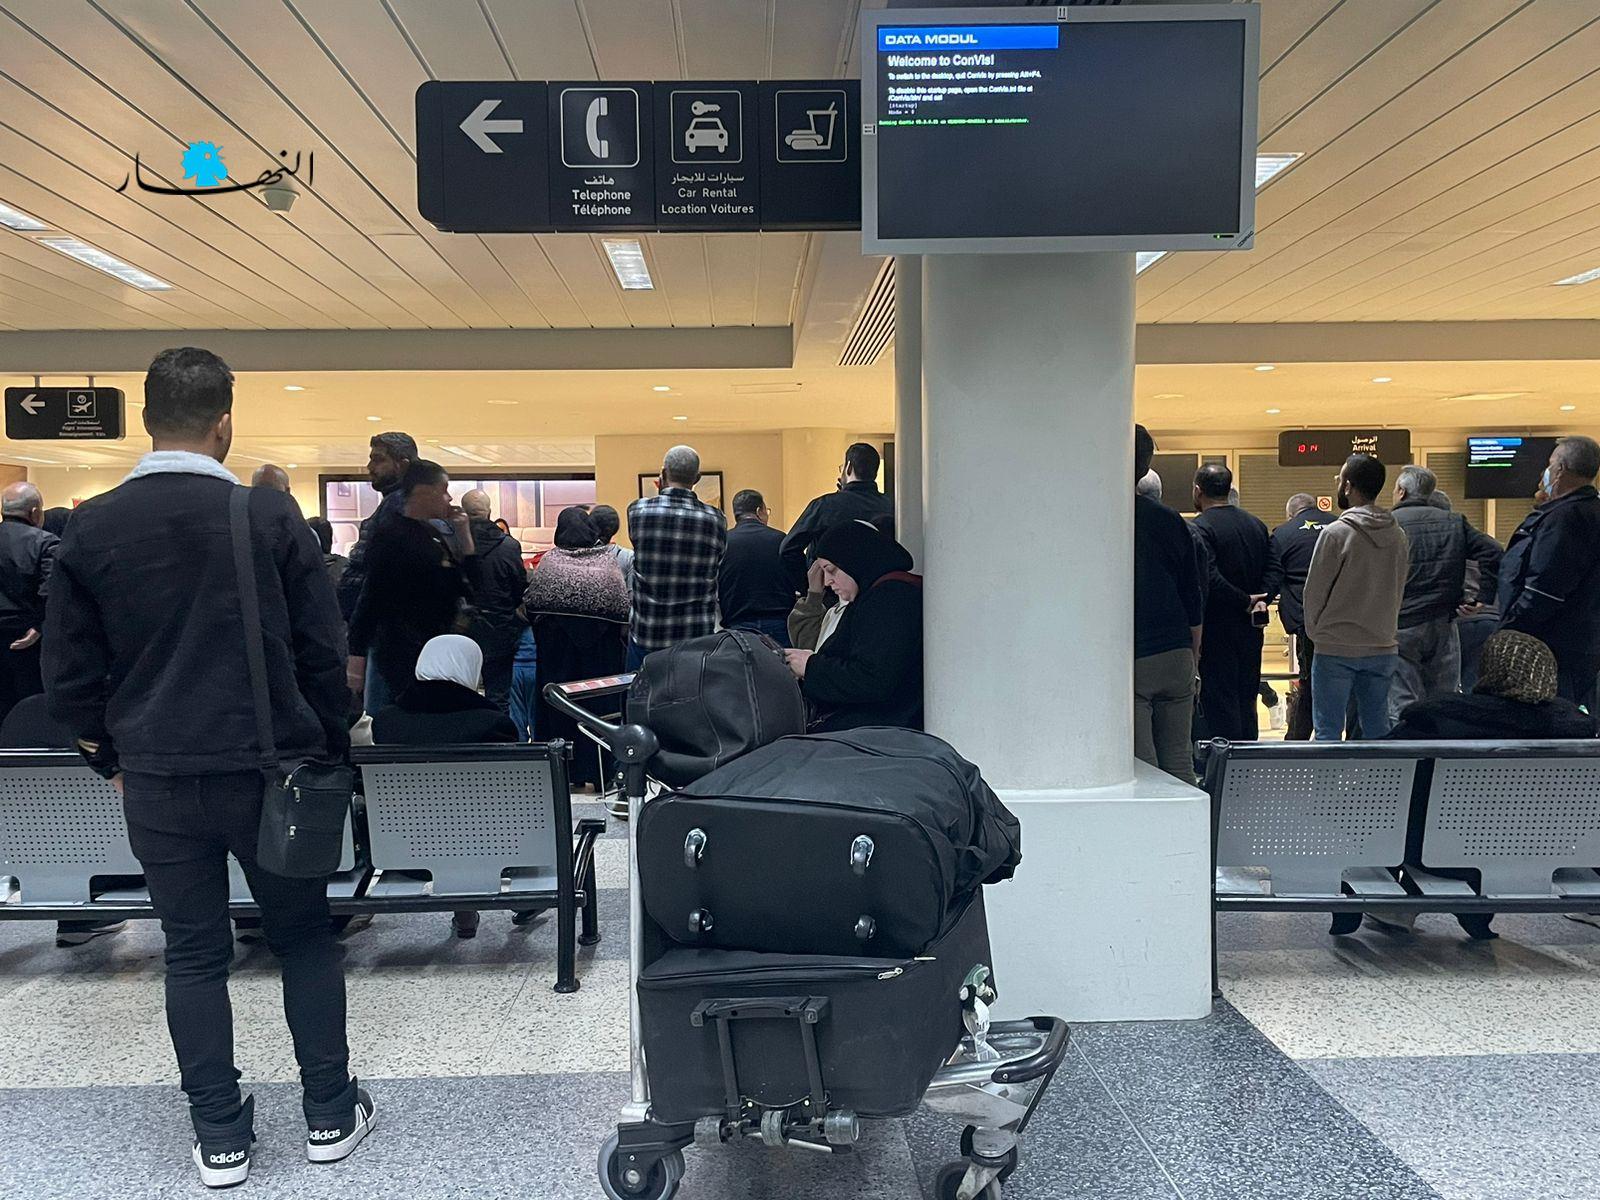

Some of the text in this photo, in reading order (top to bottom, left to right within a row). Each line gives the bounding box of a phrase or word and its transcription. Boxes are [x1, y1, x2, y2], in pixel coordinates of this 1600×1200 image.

[884, 34, 979, 45] DATA MODUL
[887, 55, 937, 67] Welcome
[939, 55, 951, 67] to
[584, 174, 615, 185] هاتف
[671, 172, 745, 184] سيارات للايجار
[572, 189, 631, 202] Telephone
[678, 187, 737, 198] Car Rental
[572, 204, 632, 217] Téléphone
[661, 203, 754, 214] Location Voitures
[1352, 436, 1378, 445] الوصول
[1352, 444, 1377, 452] Arrival
[209, 1150, 245, 1164] adidas
